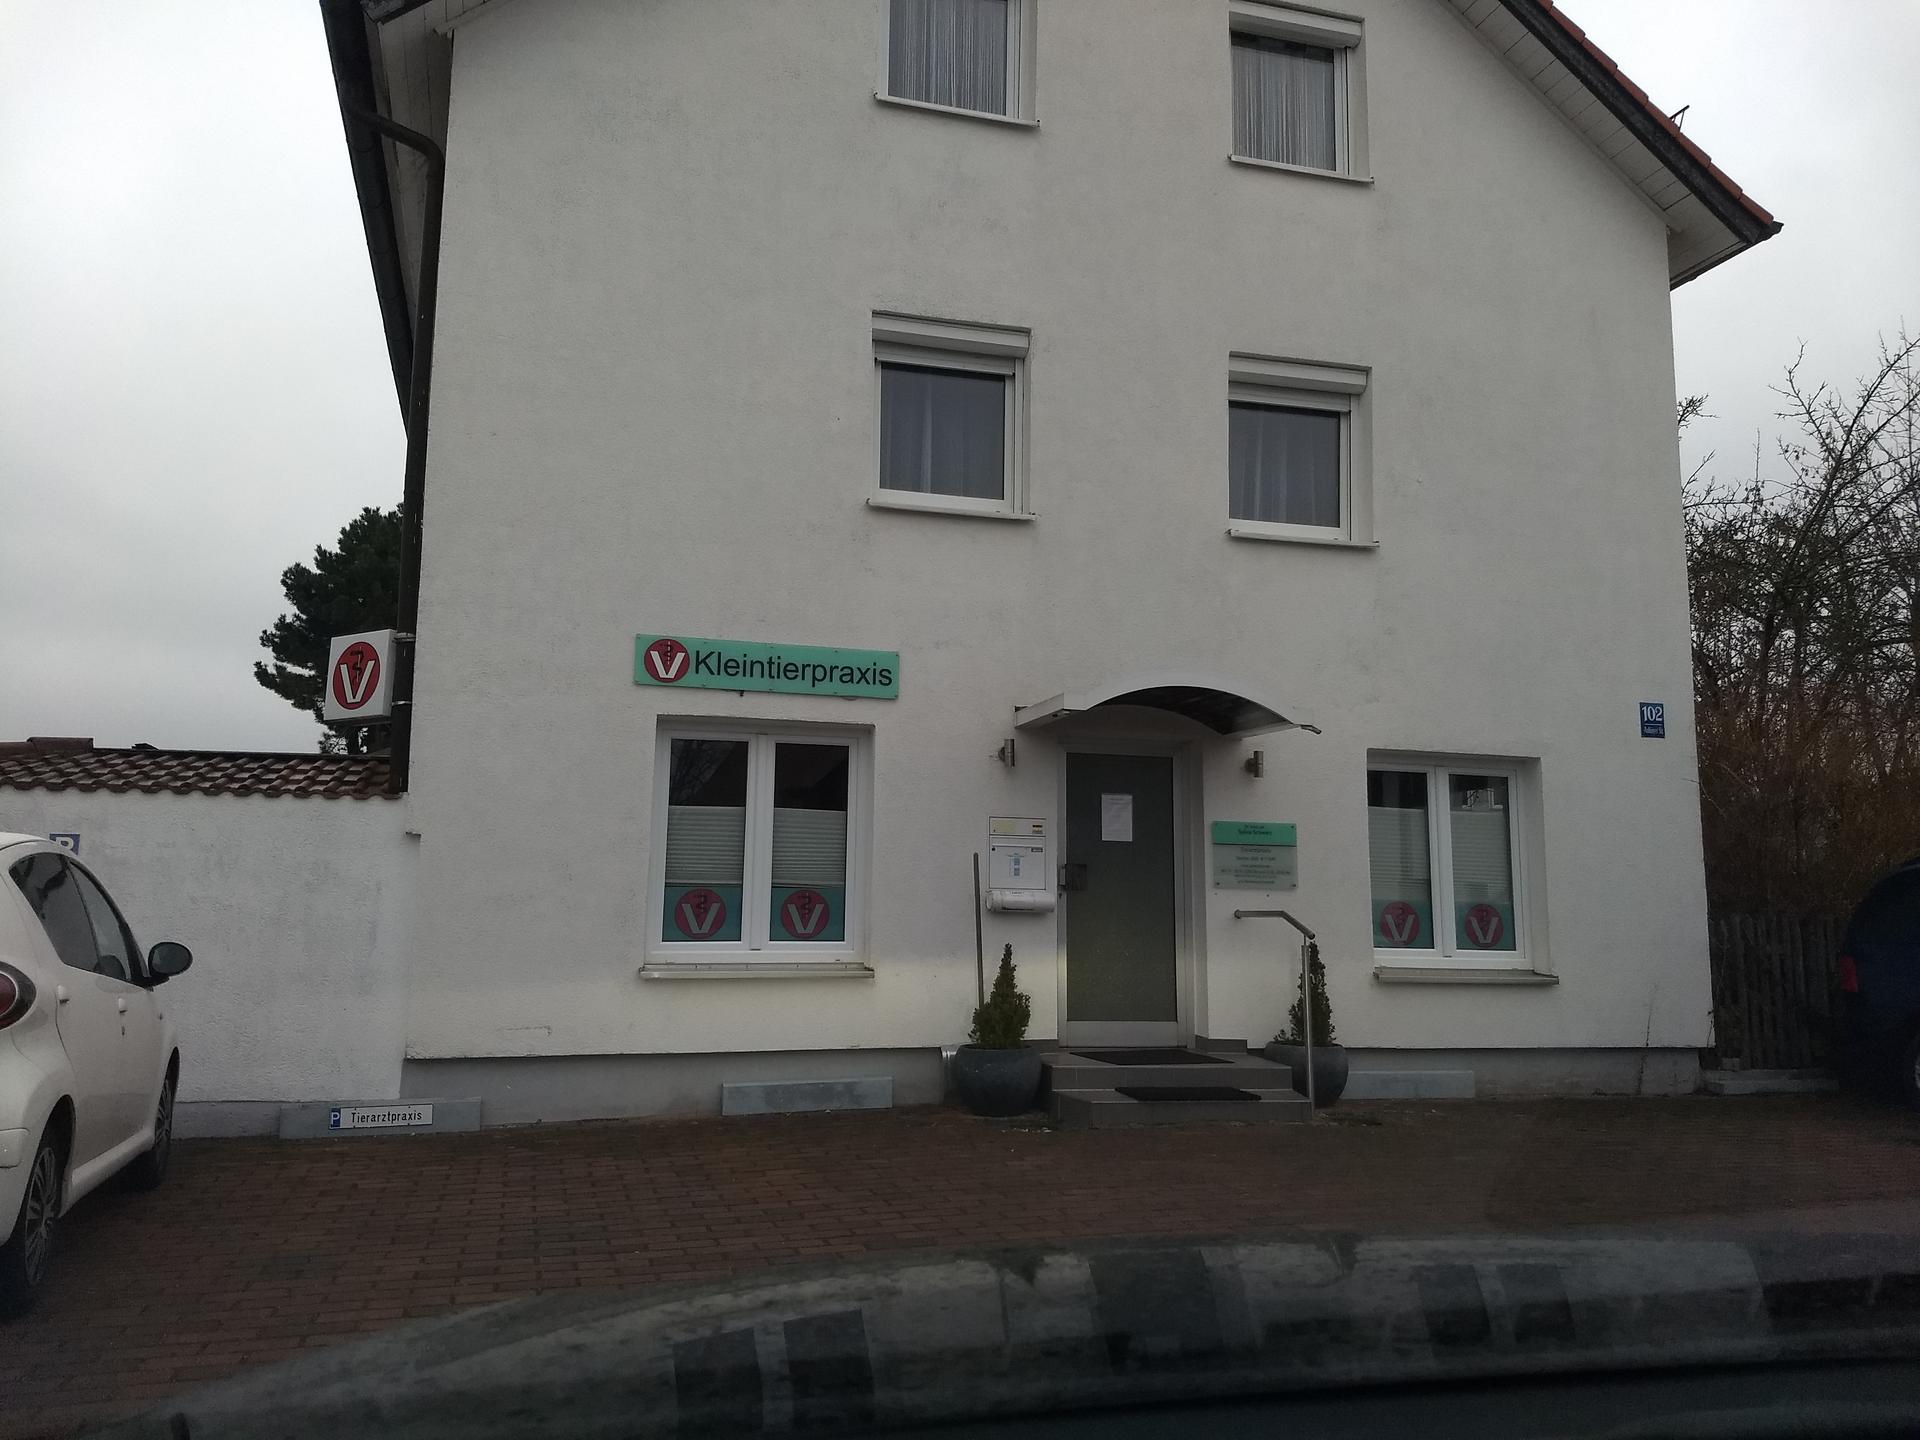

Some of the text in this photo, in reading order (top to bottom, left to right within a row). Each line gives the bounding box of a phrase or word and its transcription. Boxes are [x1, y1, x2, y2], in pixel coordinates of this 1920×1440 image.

[694, 650, 894, 687] Kleintierpraxis
[1641, 706, 1663, 721] 102
[331, 1110, 422, 1126] P Tierarztpraxis
